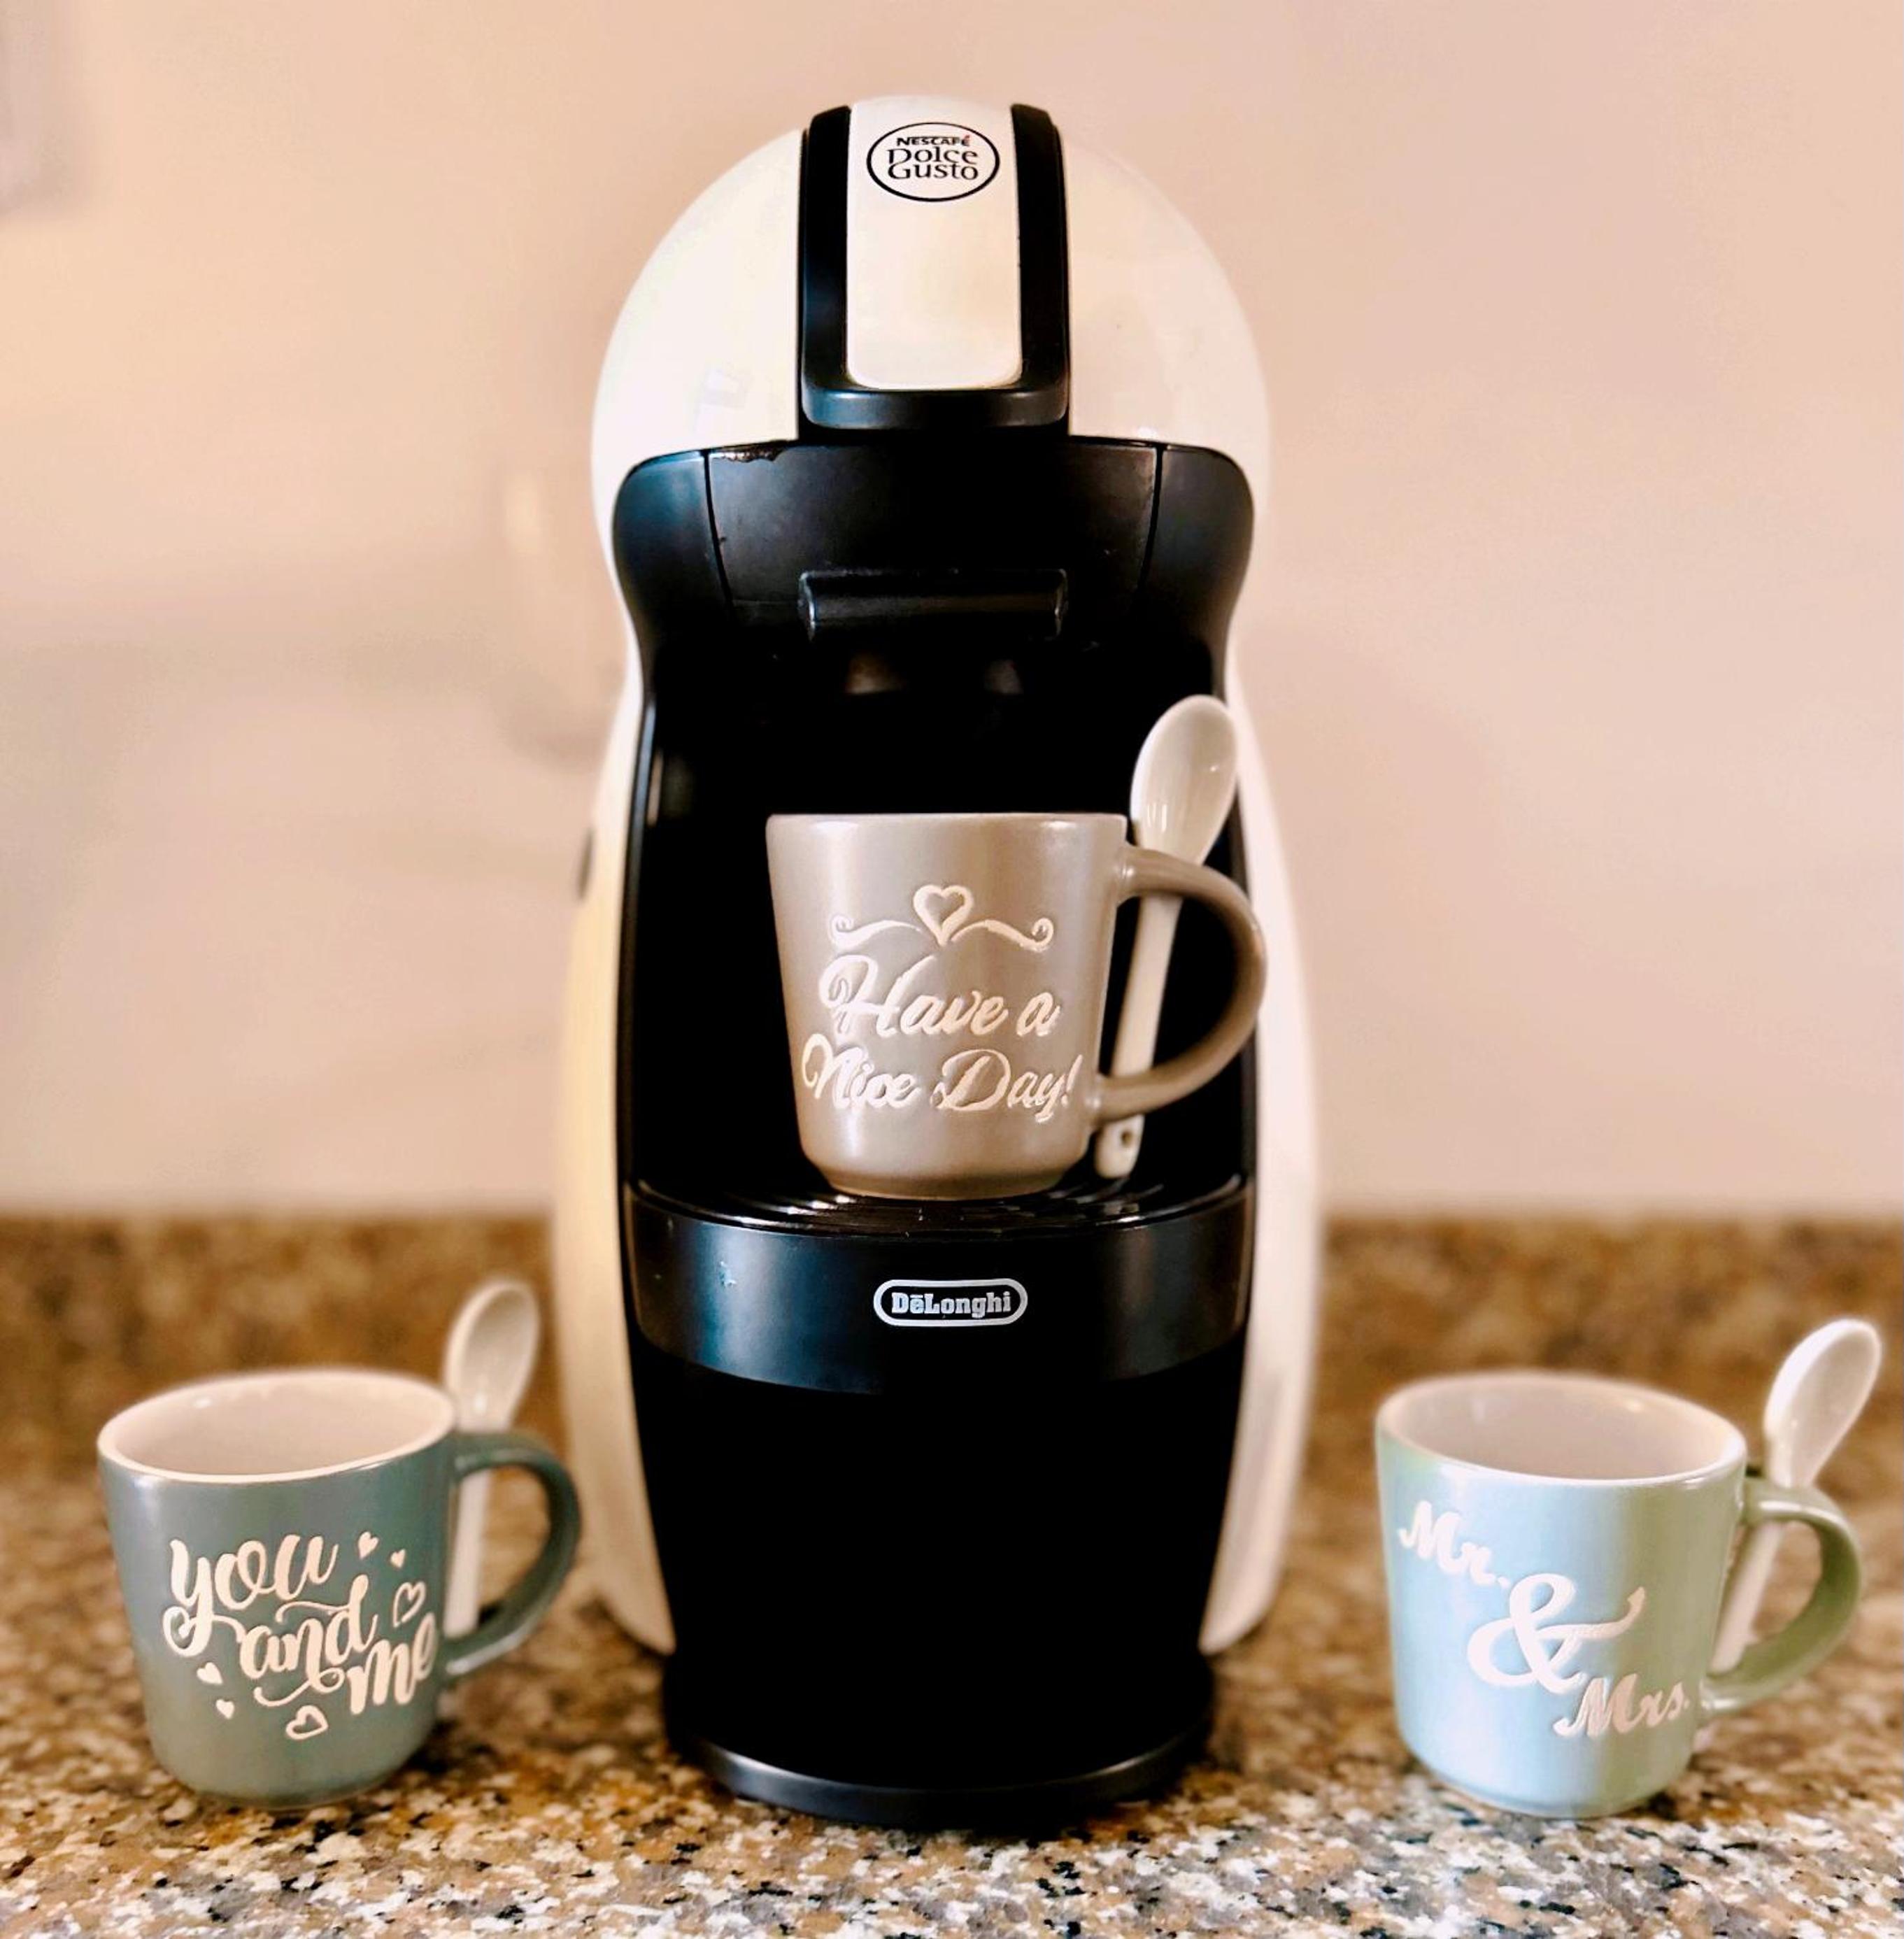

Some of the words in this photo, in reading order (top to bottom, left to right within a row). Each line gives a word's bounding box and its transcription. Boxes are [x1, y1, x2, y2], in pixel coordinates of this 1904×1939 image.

[886, 146, 978, 165] Dolce
[887, 162, 979, 180] Gusto
[818, 954, 1009, 1036] Have
[1016, 991, 1060, 1037] a
[802, 1033, 921, 1110] Nice
[930, 1049, 1083, 1123] Day!
[1397, 1500, 1511, 1589] Mr.
[162, 1534, 339, 1657] you
[1467, 1572, 1646, 1695] &
[239, 1574, 378, 1707] and
